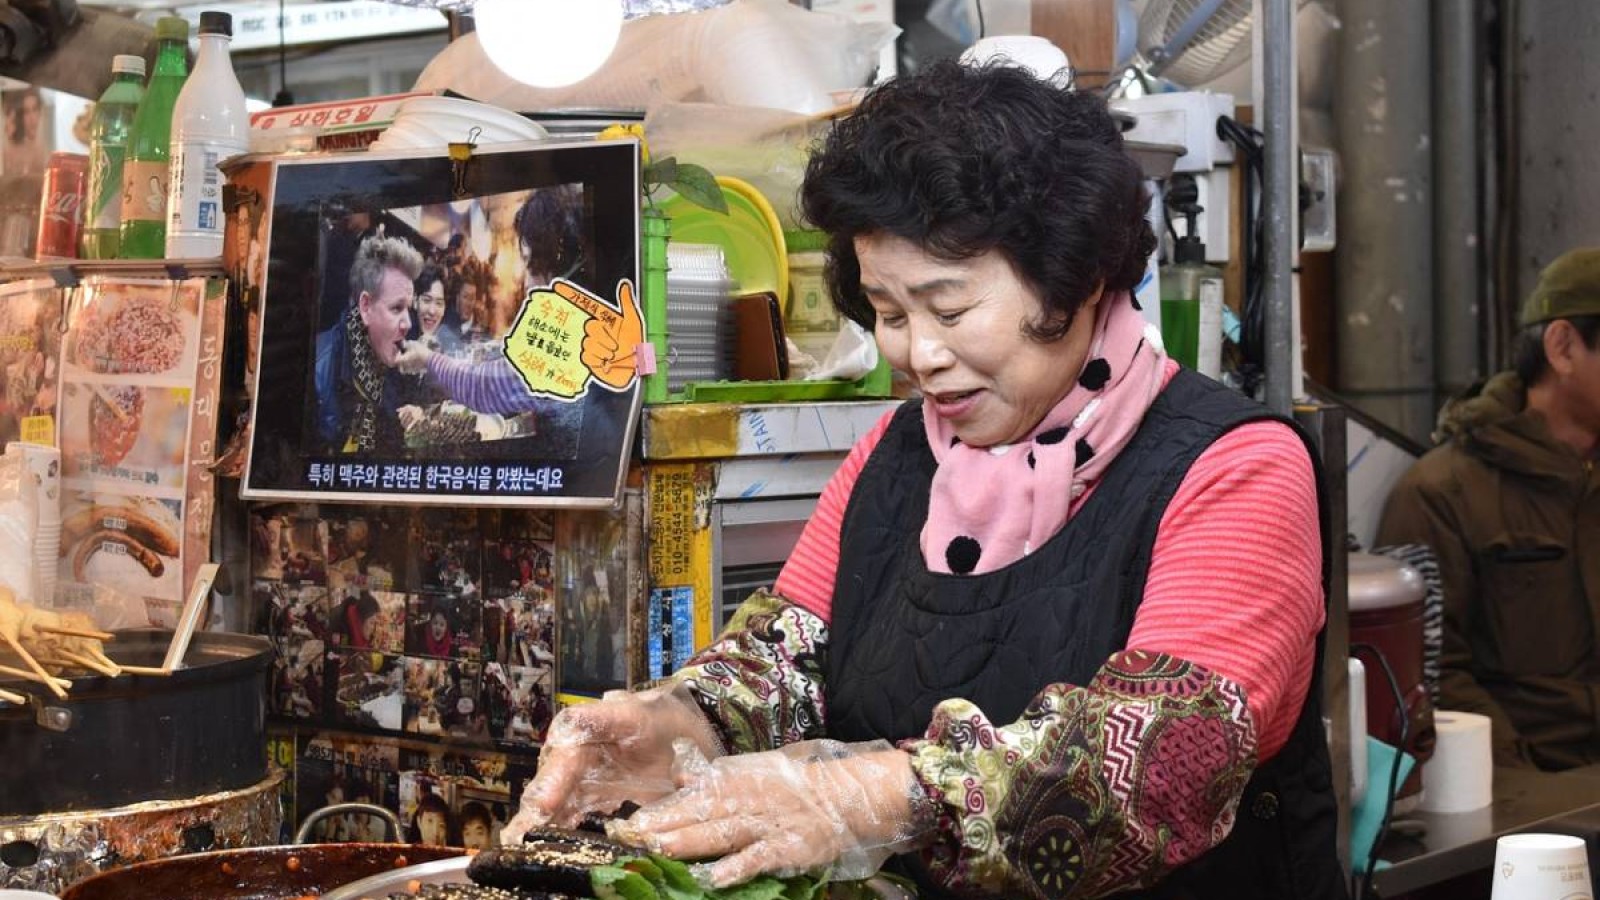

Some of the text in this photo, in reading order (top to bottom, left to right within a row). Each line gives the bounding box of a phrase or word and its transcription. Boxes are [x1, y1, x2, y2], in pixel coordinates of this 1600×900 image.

[308, 463, 563, 492] 특히 맥주와 관련된 한국음식을 맛봤는데요
